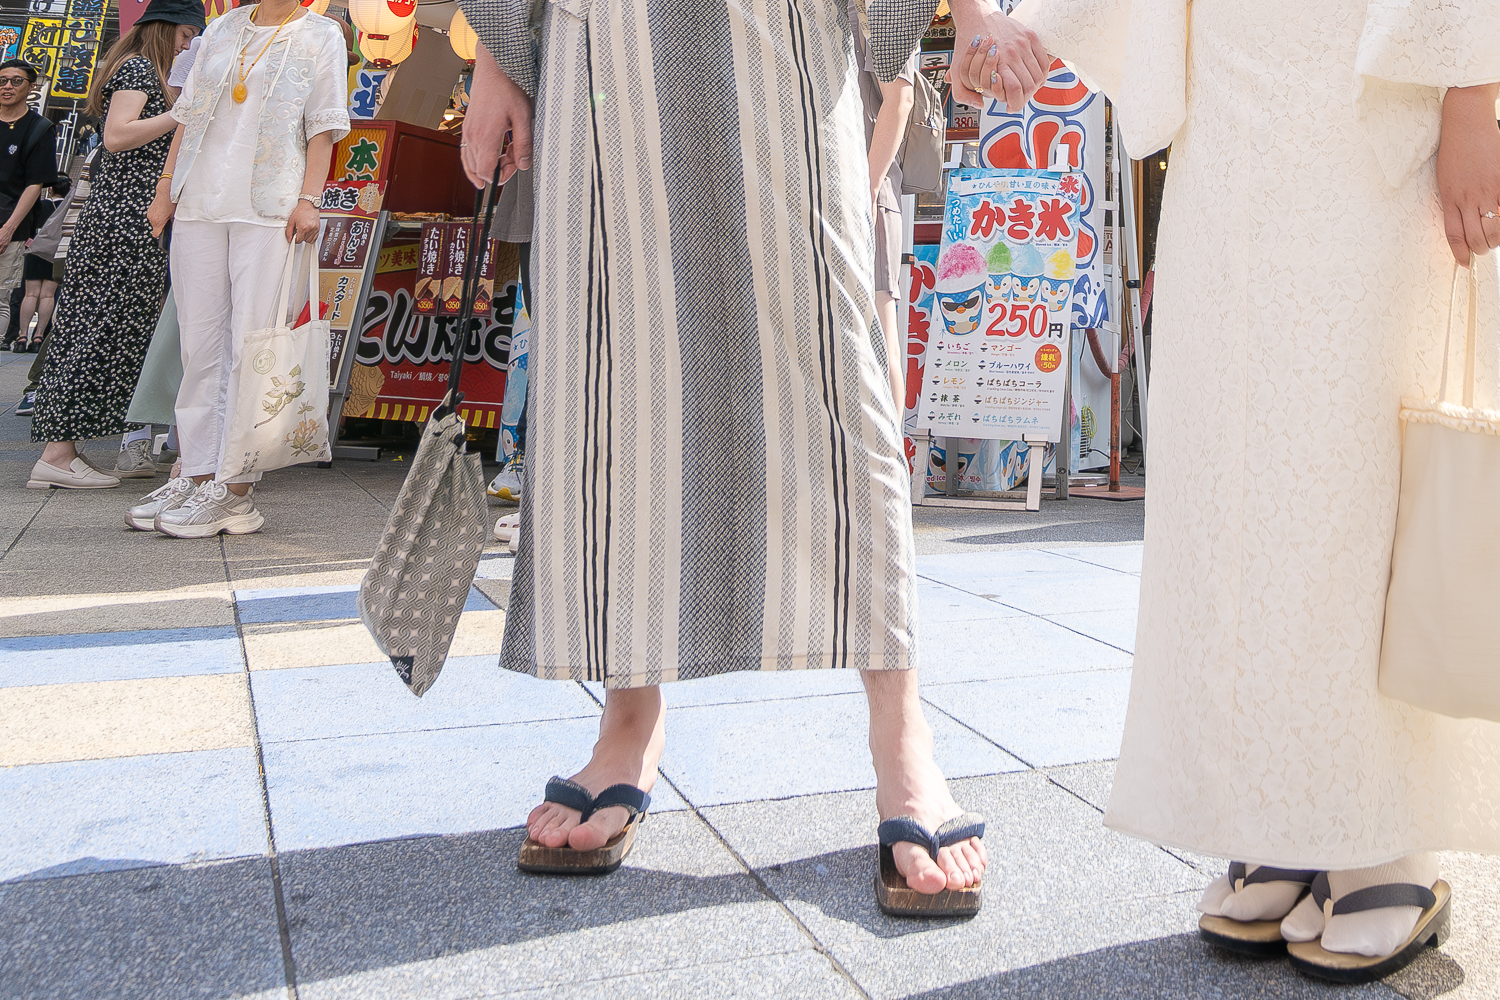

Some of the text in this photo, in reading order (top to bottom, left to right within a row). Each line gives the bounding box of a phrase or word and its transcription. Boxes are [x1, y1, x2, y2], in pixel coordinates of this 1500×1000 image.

[1059, 175, 1080, 193] 氷
[321, 187, 359, 211] 焼き
[970, 199, 1073, 241] かき氷
[344, 221, 364, 262] あんこ
[427, 226, 440, 276] たい焼き
[454, 226, 467, 276] たい焼き
[421, 237, 430, 275] チョコレート
[448, 242, 456, 275] カスタード
[331, 276, 350, 321] カスタード
[985, 303, 1064, 339] 250円
[947, 343, 971, 351] いちご
[1040, 353, 1056, 361] 練乳
[945, 360, 968, 368] メロン
[989, 361, 1031, 370] ブルーハワイ
[390, 370, 412, 381] Taiyaki
[943, 377, 966, 385] レモン
[940, 394, 960, 403] 抹茶
[938, 412, 961, 421] みぞれ
